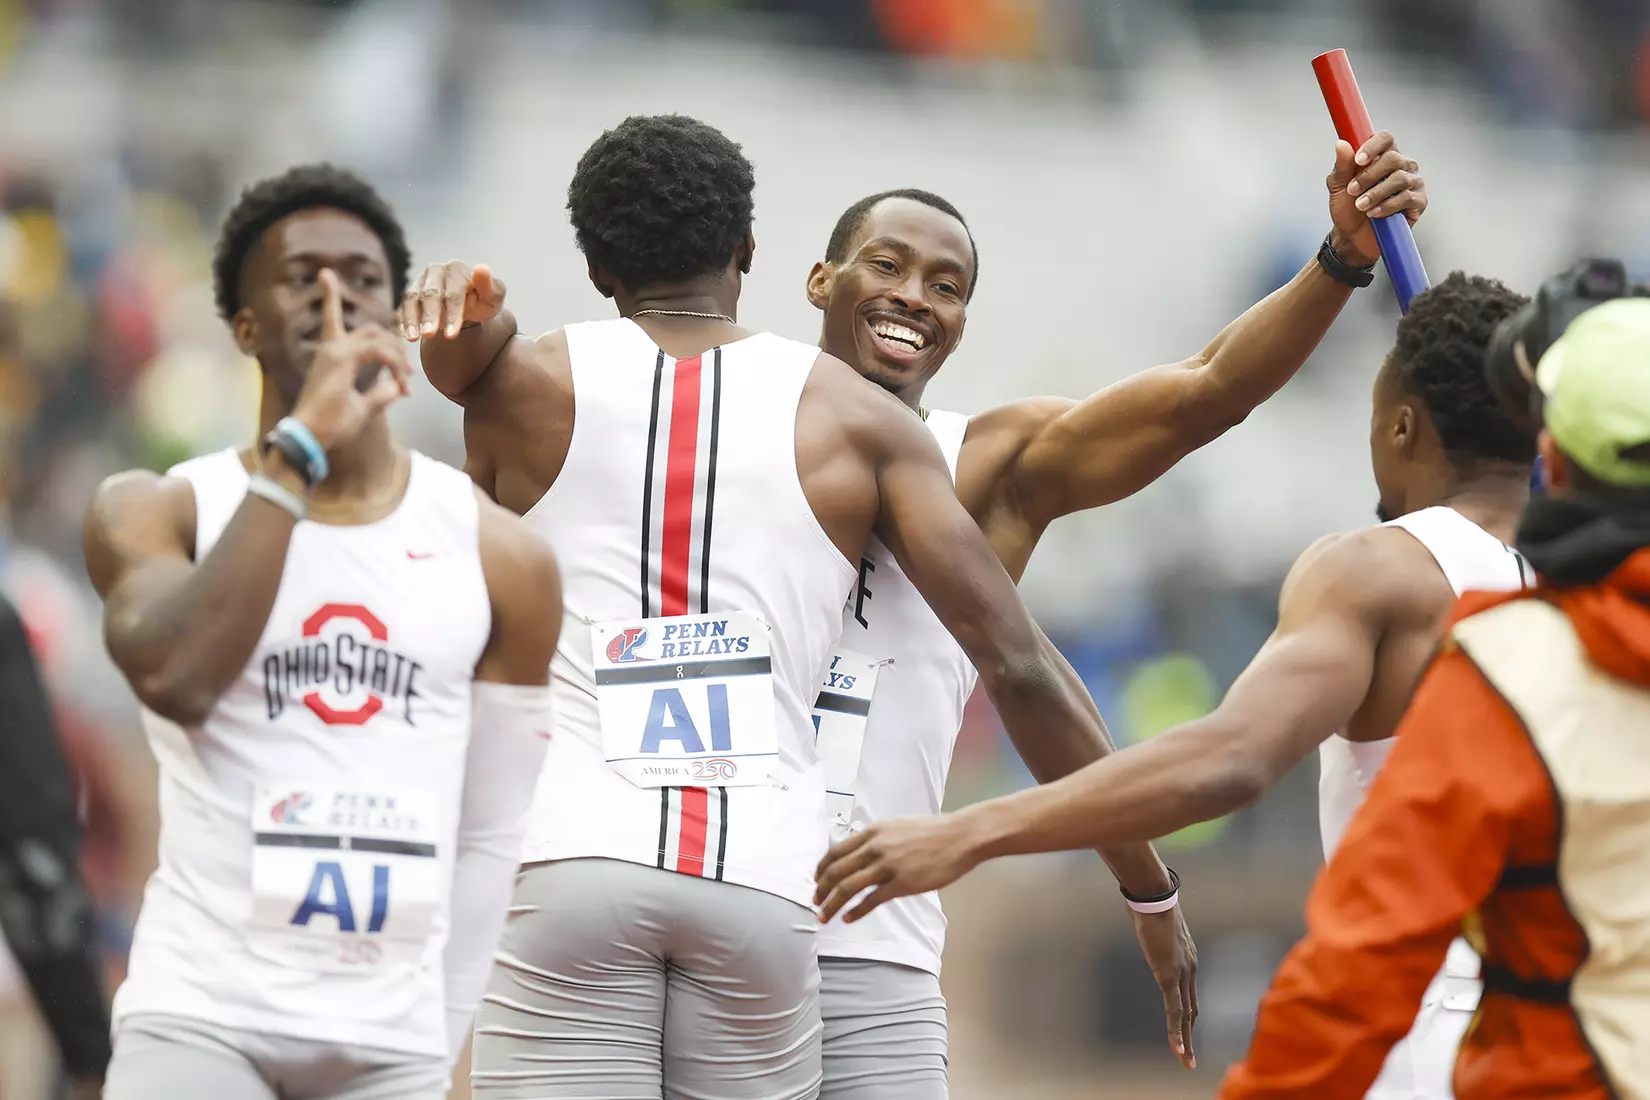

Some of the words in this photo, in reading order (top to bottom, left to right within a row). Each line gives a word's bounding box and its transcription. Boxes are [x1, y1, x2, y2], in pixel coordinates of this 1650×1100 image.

[660, 636, 750, 659] RELAYS
[662, 620, 728, 640] PENN
[264, 642, 329, 720] OHIO
[335, 633, 424, 727] STATE
[639, 684, 732, 753] AI
[641, 766, 690, 776] AMERICA
[691, 758, 738, 782] 250
[290, 862, 389, 932] AI
